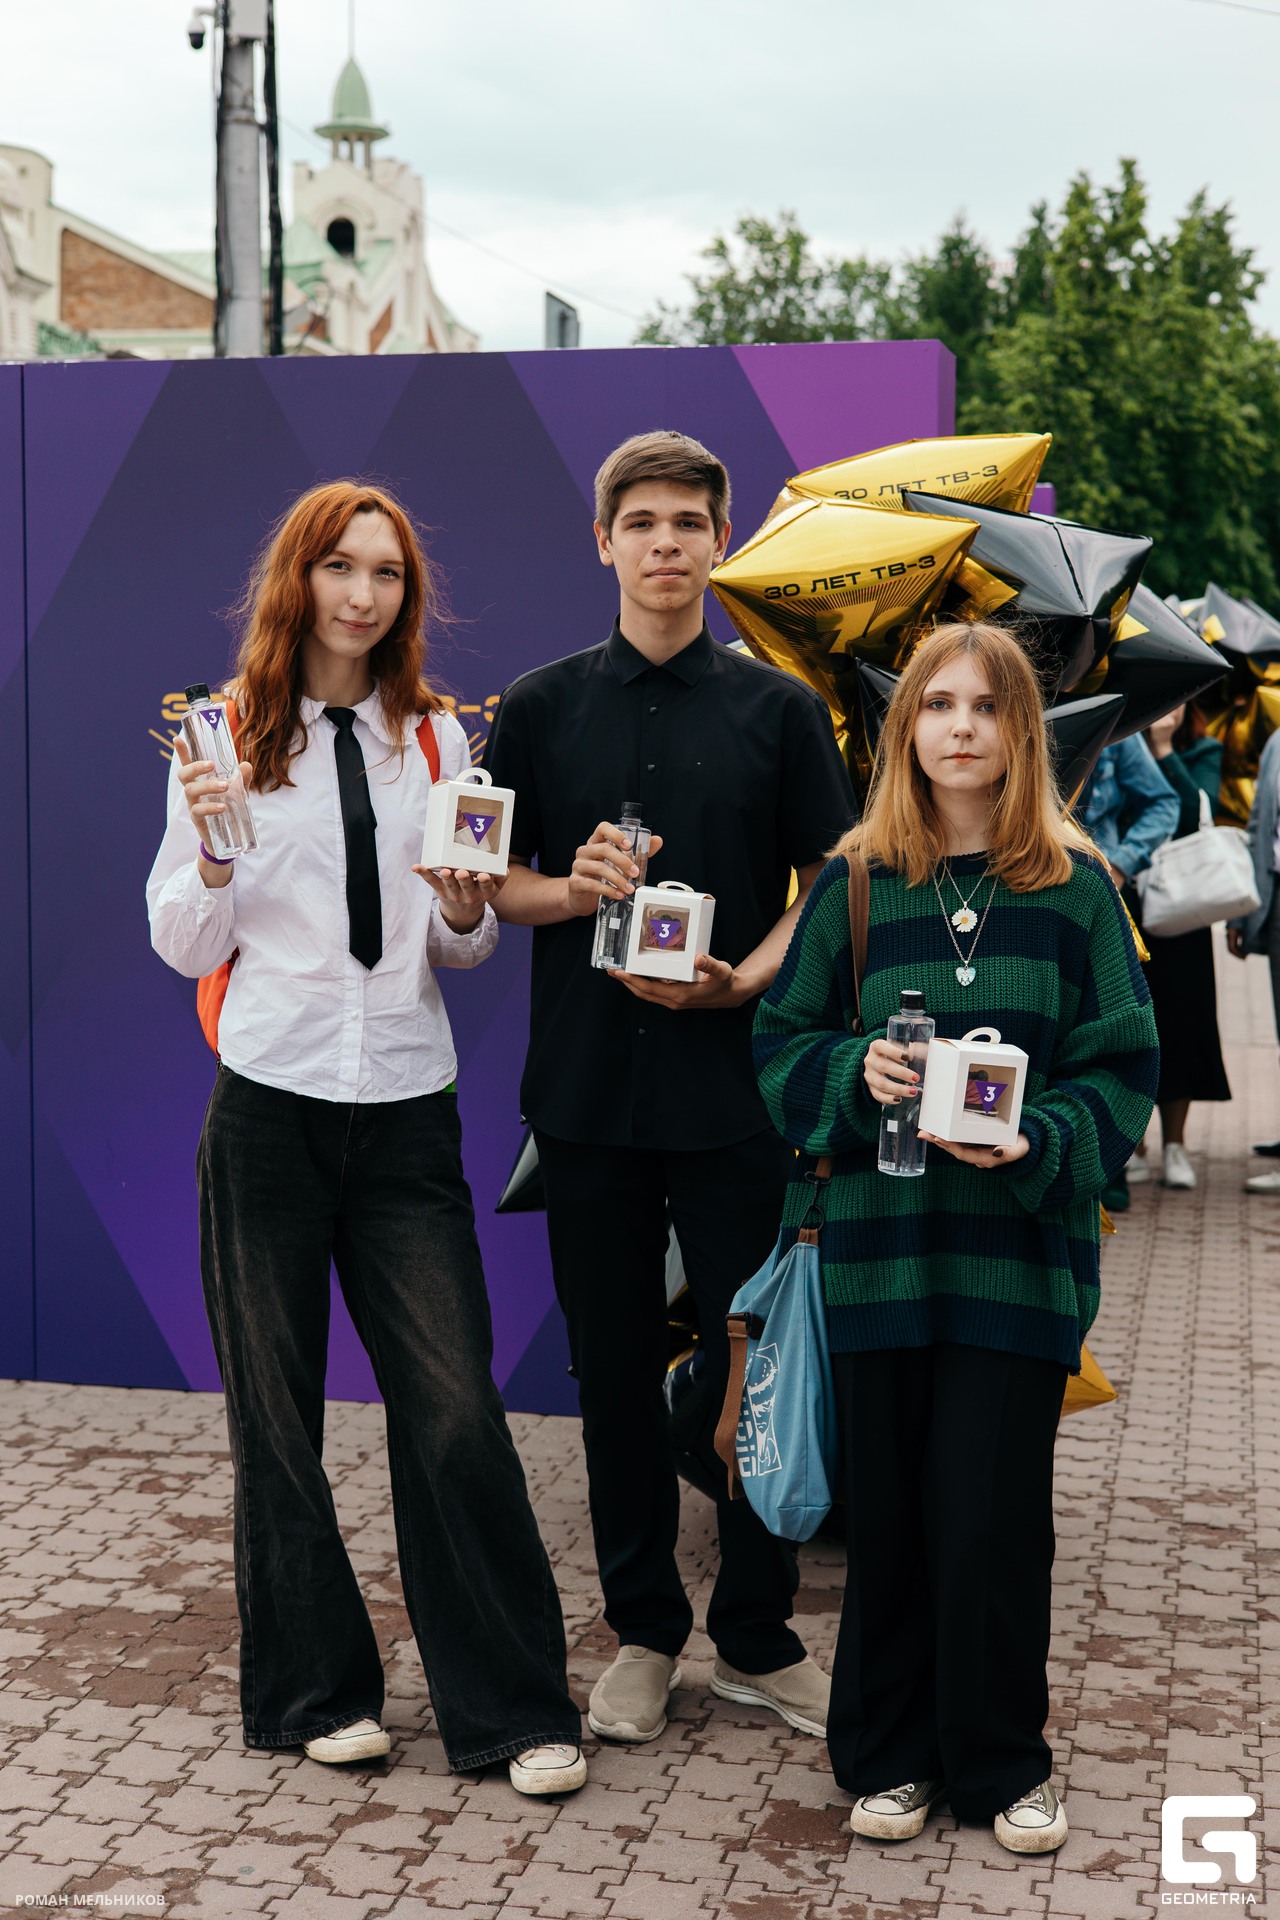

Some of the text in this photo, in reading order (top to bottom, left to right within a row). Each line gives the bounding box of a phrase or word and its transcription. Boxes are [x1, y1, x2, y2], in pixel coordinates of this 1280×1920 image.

[834, 465, 999, 500] 30 ЛЕТ ТВ-3
[764, 555, 936, 600] 30 ЛЕТ ТВ-3
[208, 711, 218, 724] 3
[474, 817, 486, 833] 3
[659, 923, 671, 939] 3
[983, 1086, 997, 1102] 3
